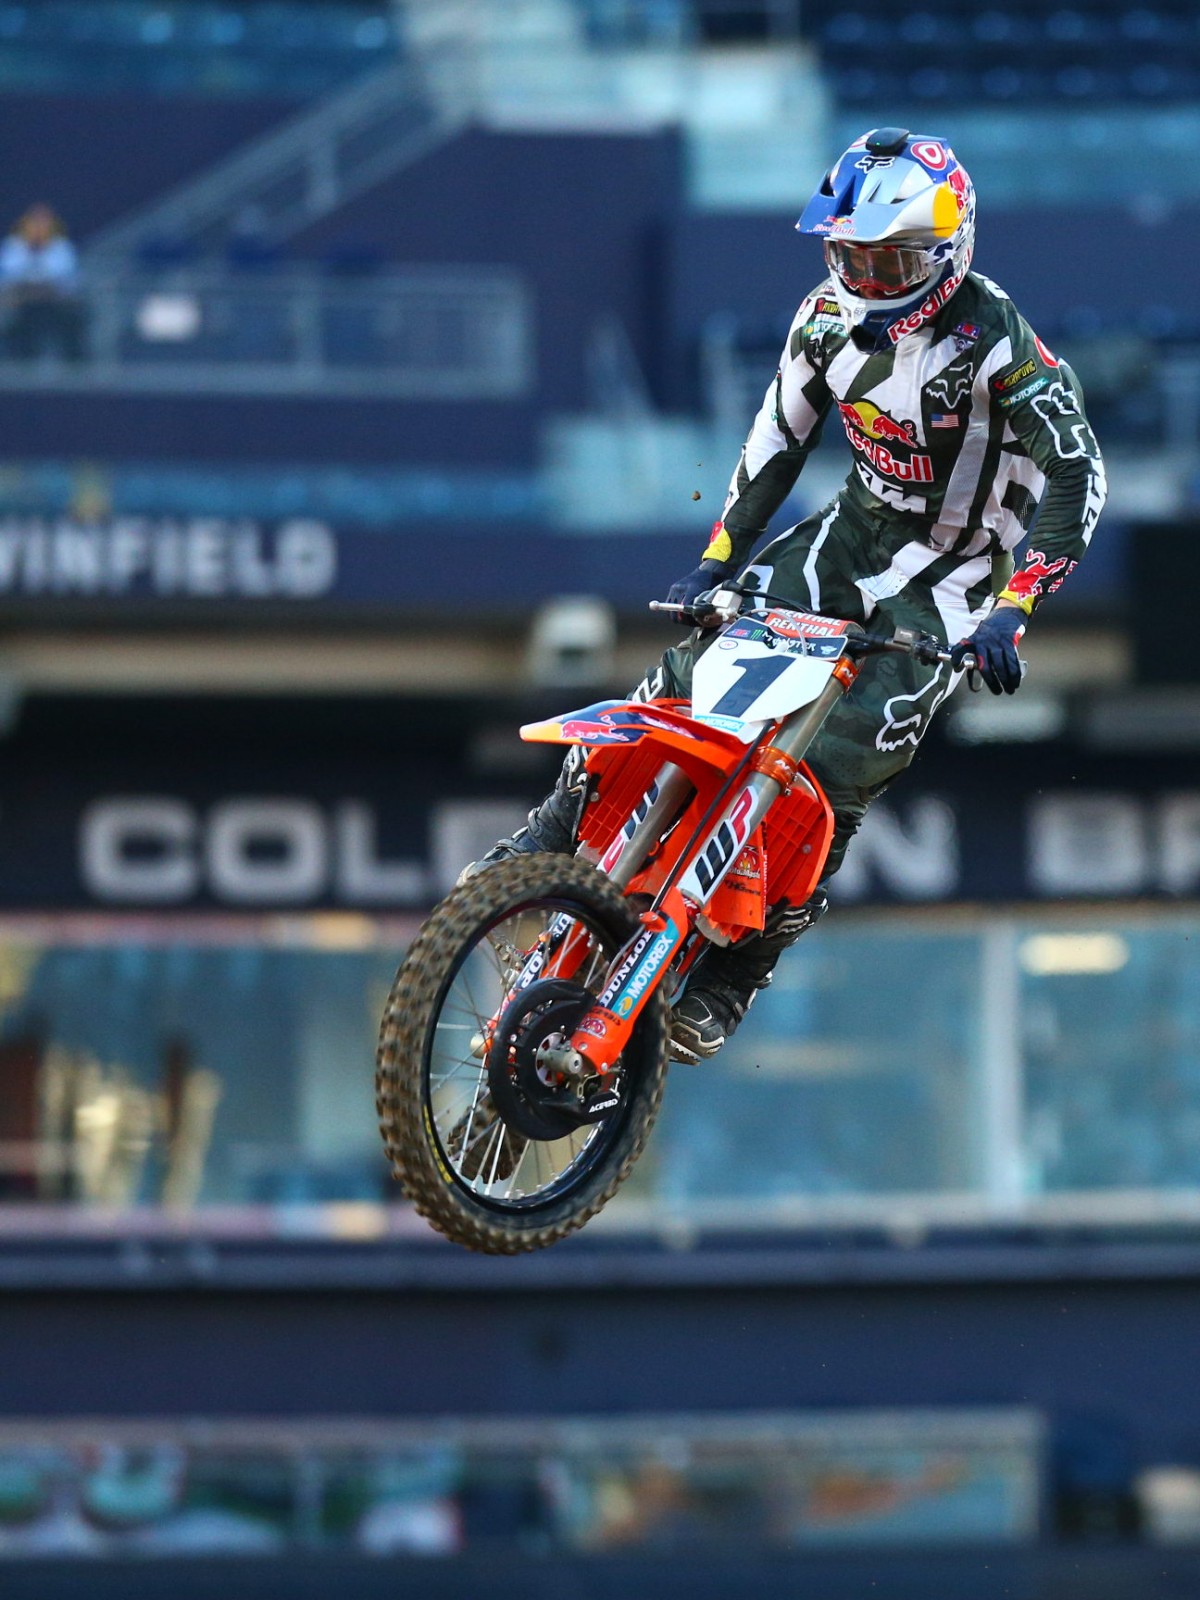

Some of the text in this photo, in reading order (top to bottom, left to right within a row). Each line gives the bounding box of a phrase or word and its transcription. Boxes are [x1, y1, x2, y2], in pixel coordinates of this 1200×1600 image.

[887, 245, 974, 344] Red Bull
[874, 444, 935, 482] Bull
[768, 617, 836, 637] RENTHAL
[709, 654, 797, 718] 1
[694, 787, 753, 897] WP
[626, 934, 674, 999] MOTOREX
